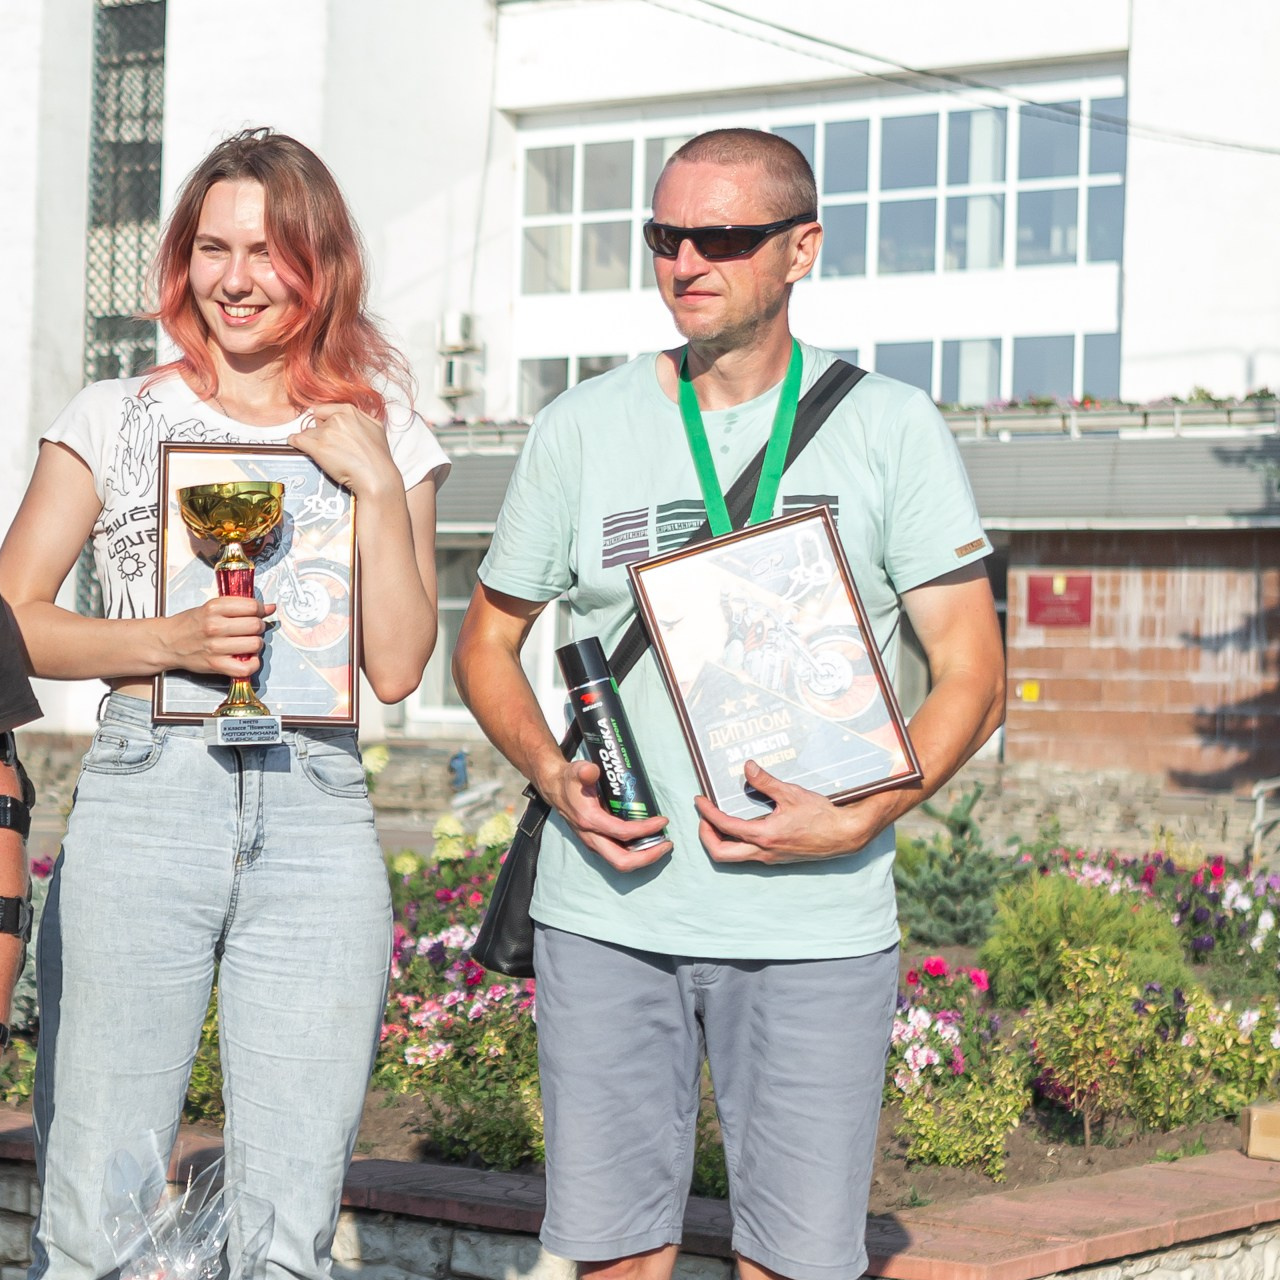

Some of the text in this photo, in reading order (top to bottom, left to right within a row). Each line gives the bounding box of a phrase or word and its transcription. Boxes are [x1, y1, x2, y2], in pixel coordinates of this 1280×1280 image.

[708, 709, 791, 751] ДИПЛОМ
[742, 743, 751, 758] 2
[751, 732, 790, 754] МЕСТО
[599, 748, 621, 796] МОТО
